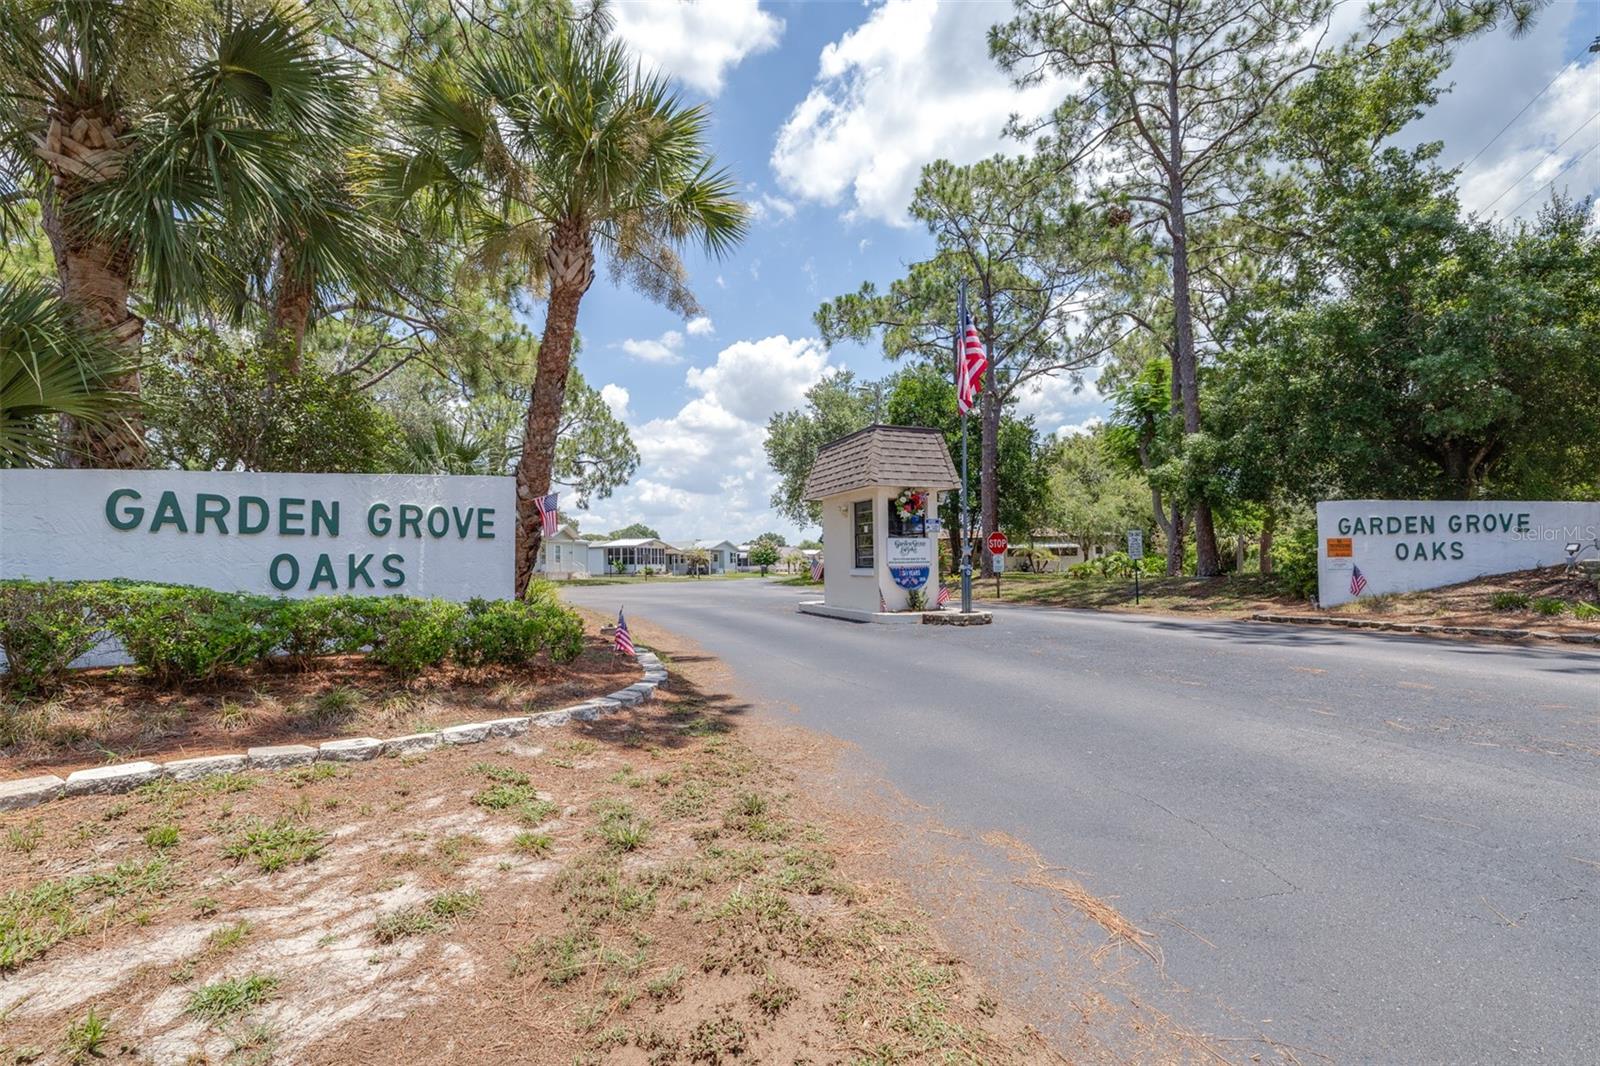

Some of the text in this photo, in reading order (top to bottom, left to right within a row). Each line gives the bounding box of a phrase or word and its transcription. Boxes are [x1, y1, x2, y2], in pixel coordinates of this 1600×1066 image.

[105, 488, 496, 539] GARDEN GROVE
[1338, 513, 1531, 536] GARDEN GROVE
[989, 538, 1007, 549] STOP
[1395, 541, 1464, 561] OAKS
[269, 553, 406, 591] OAKS
